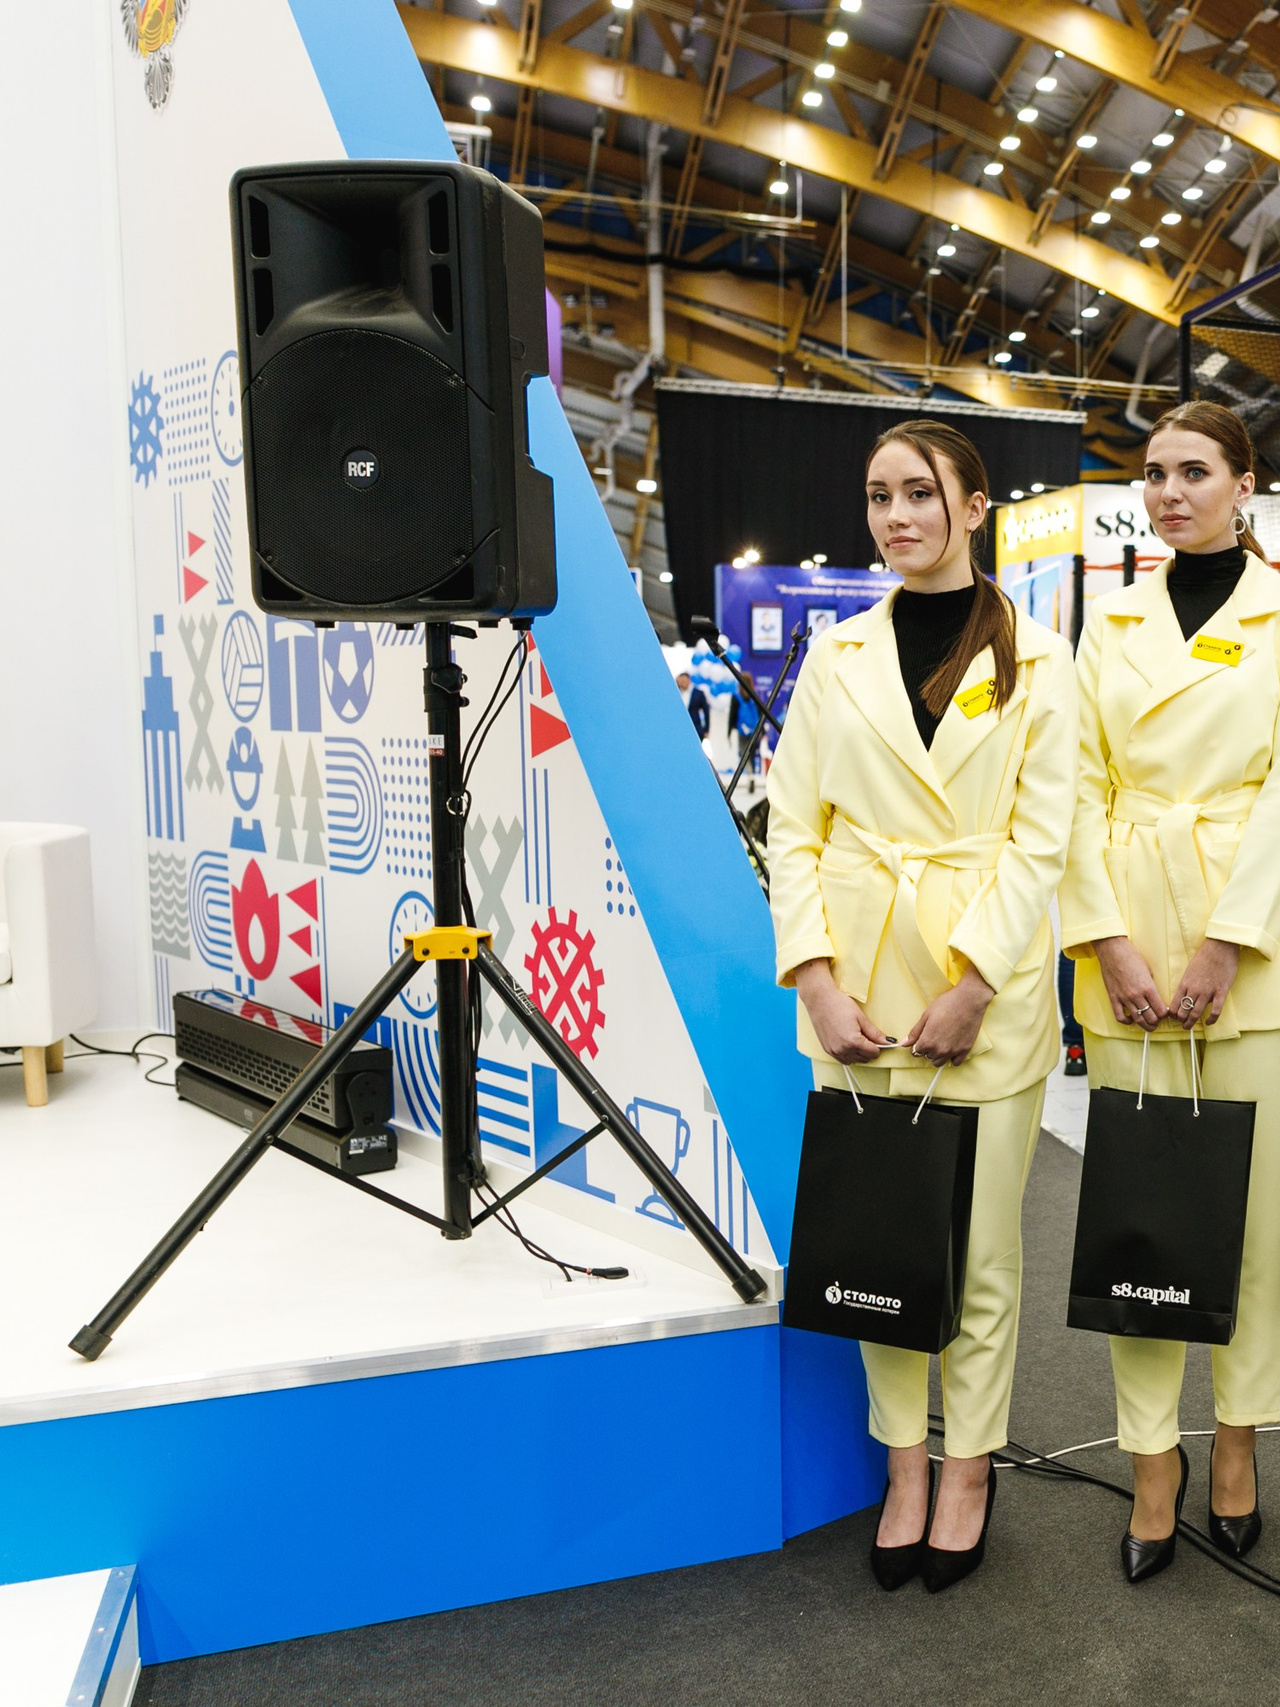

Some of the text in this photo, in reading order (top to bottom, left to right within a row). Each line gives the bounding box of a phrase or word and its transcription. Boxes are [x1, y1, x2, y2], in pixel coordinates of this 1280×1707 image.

[348, 461, 375, 477] RCF
[843, 1289, 902, 1309] СТОЛОТО
[1111, 1282, 1190, 1306] s8.capital
